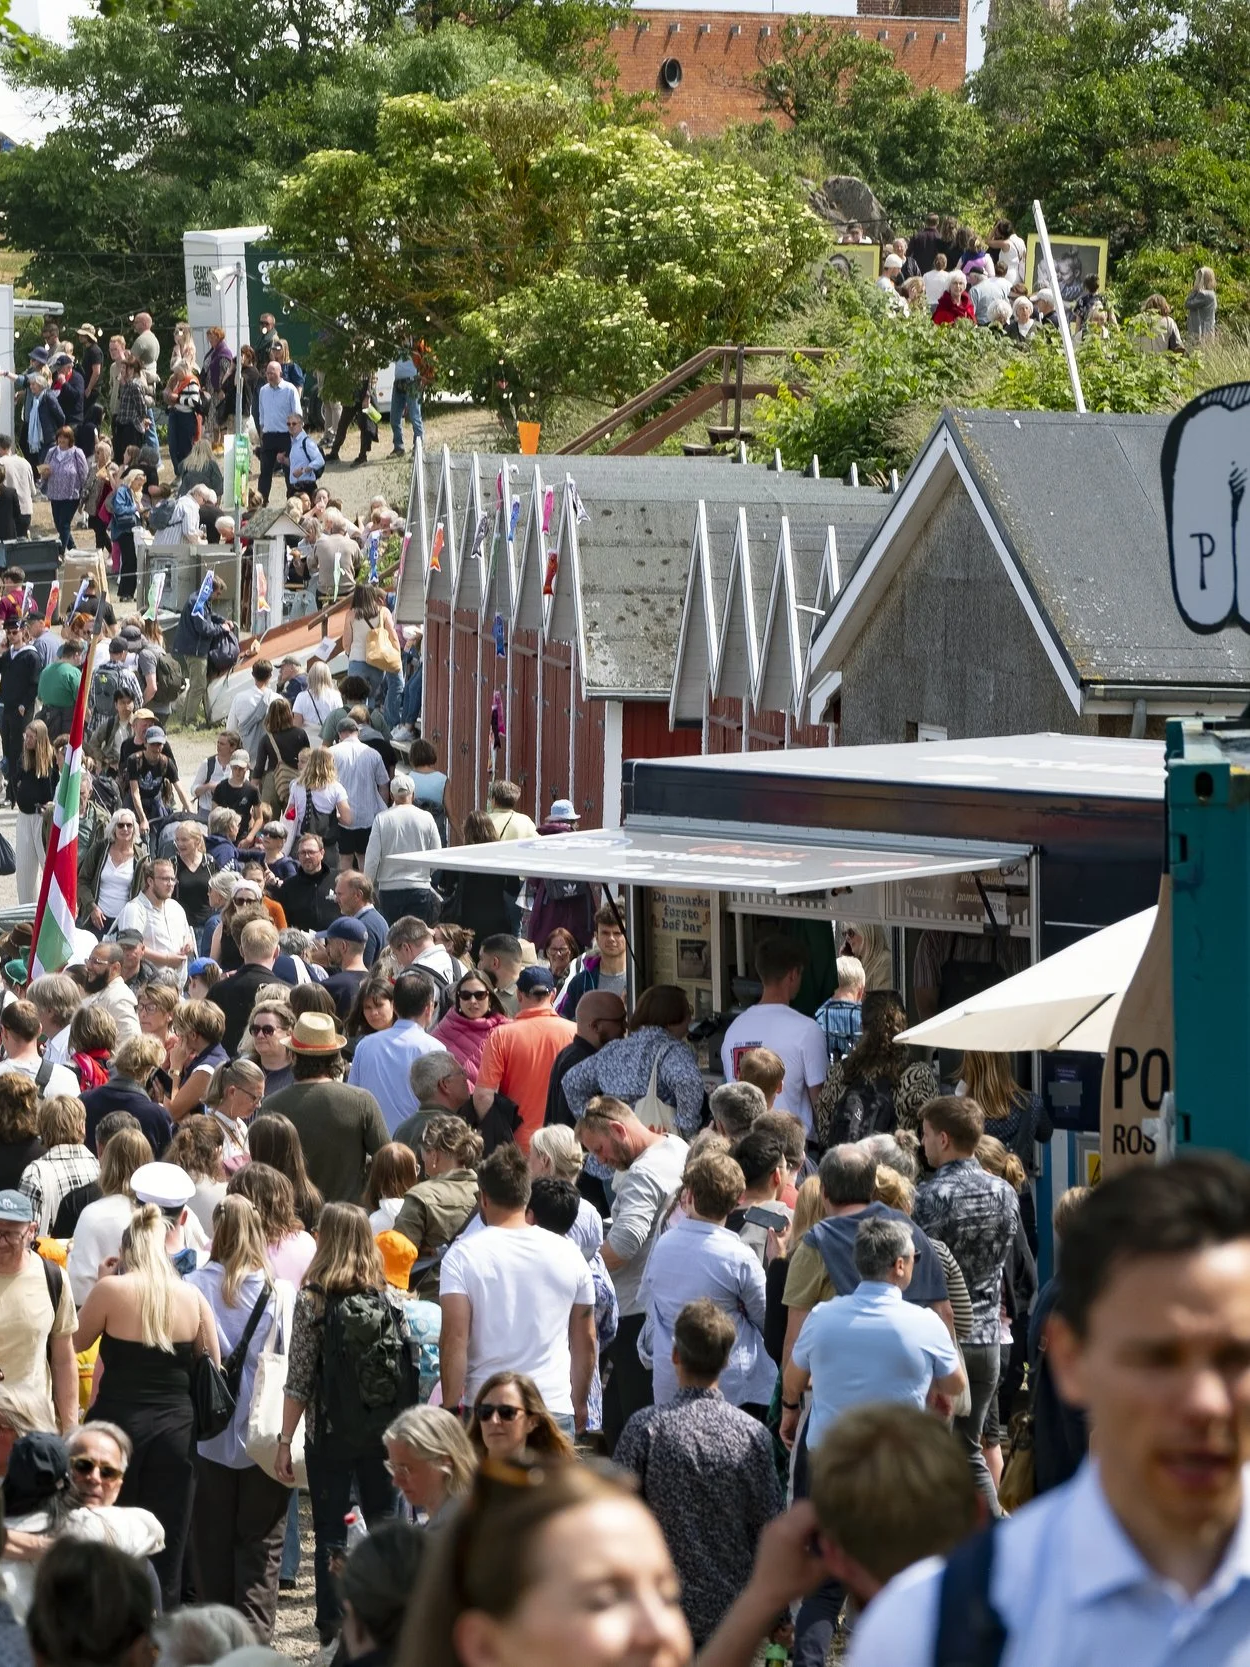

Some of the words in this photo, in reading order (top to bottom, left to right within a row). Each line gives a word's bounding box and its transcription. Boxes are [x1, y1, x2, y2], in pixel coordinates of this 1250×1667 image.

[1190, 532, 1216, 591] P
[653, 891, 710, 908] Danmarks
[682, 920, 703, 933] bar
